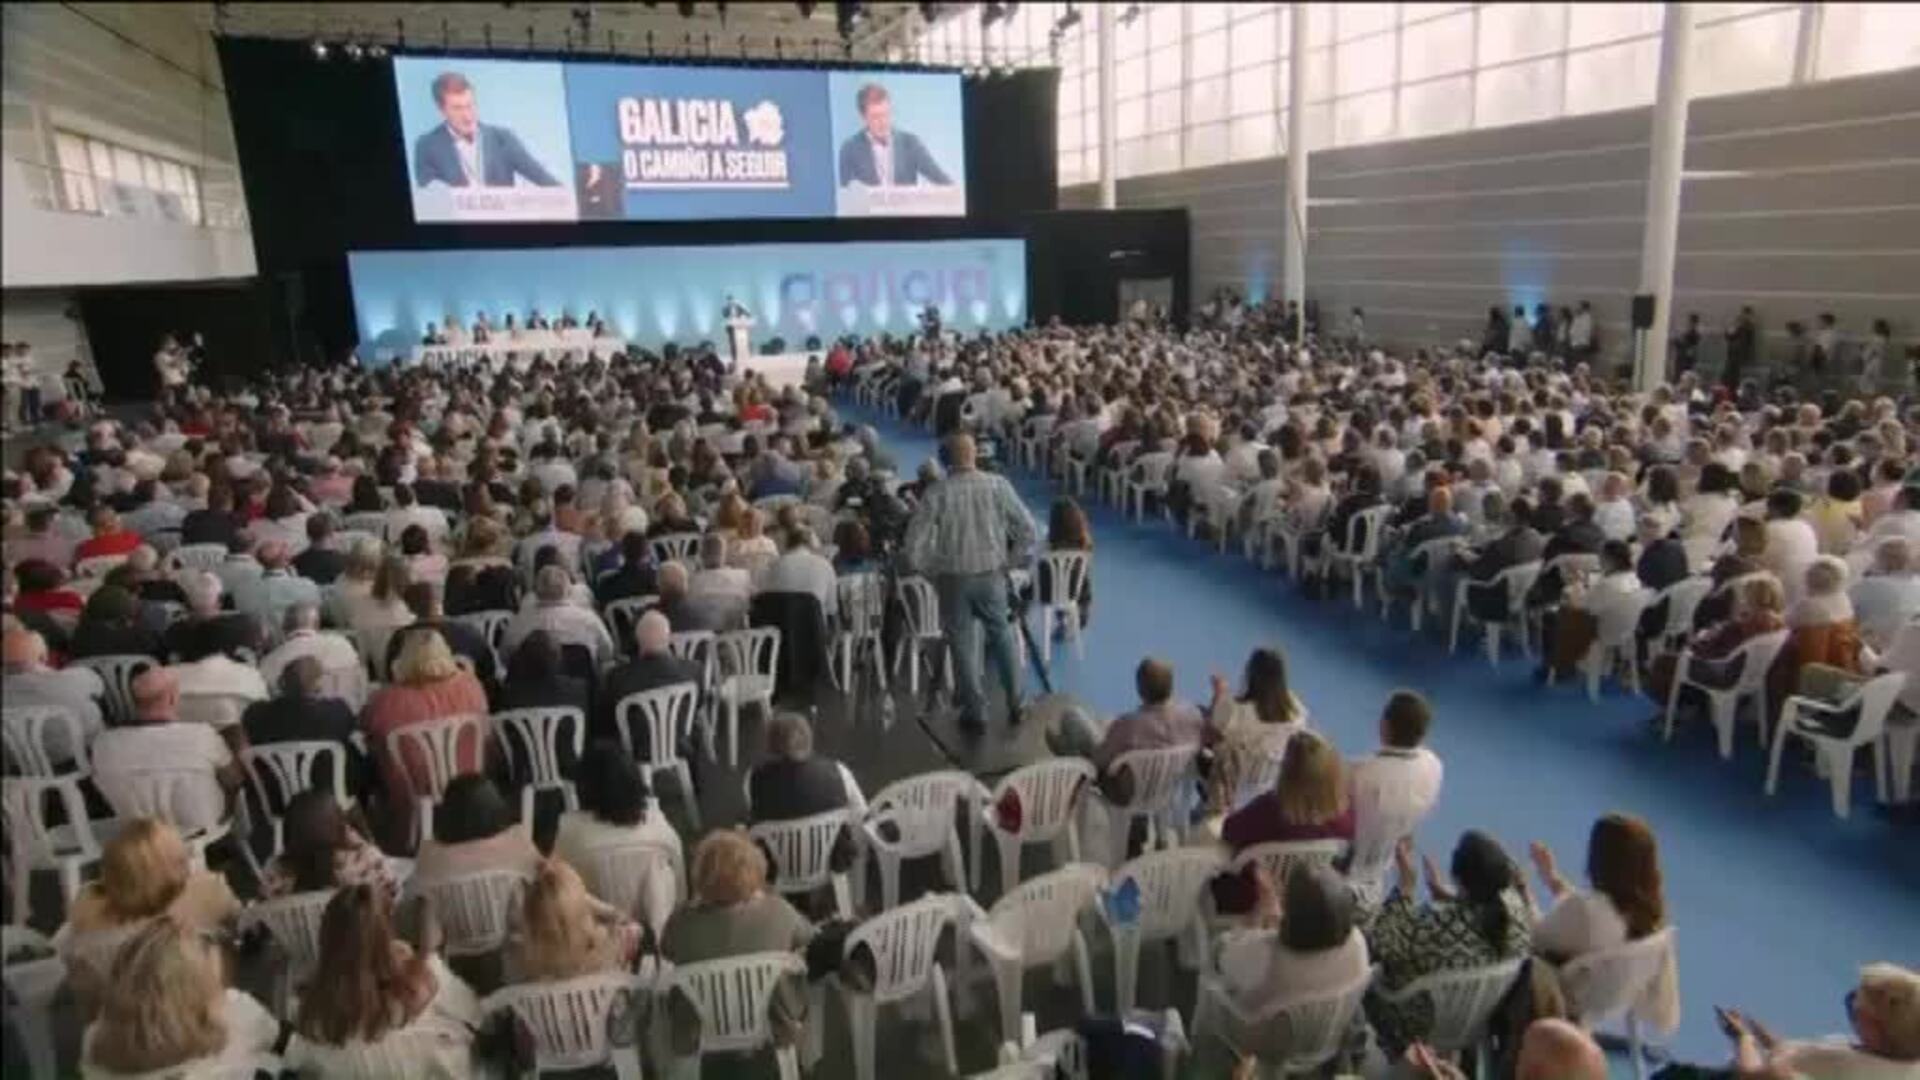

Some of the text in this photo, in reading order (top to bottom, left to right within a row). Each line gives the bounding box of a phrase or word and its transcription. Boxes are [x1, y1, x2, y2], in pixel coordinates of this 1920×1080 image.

[618, 97, 739, 145] GALICIA
[624, 146, 788, 181] O CAMIÑO A SEGUIR
